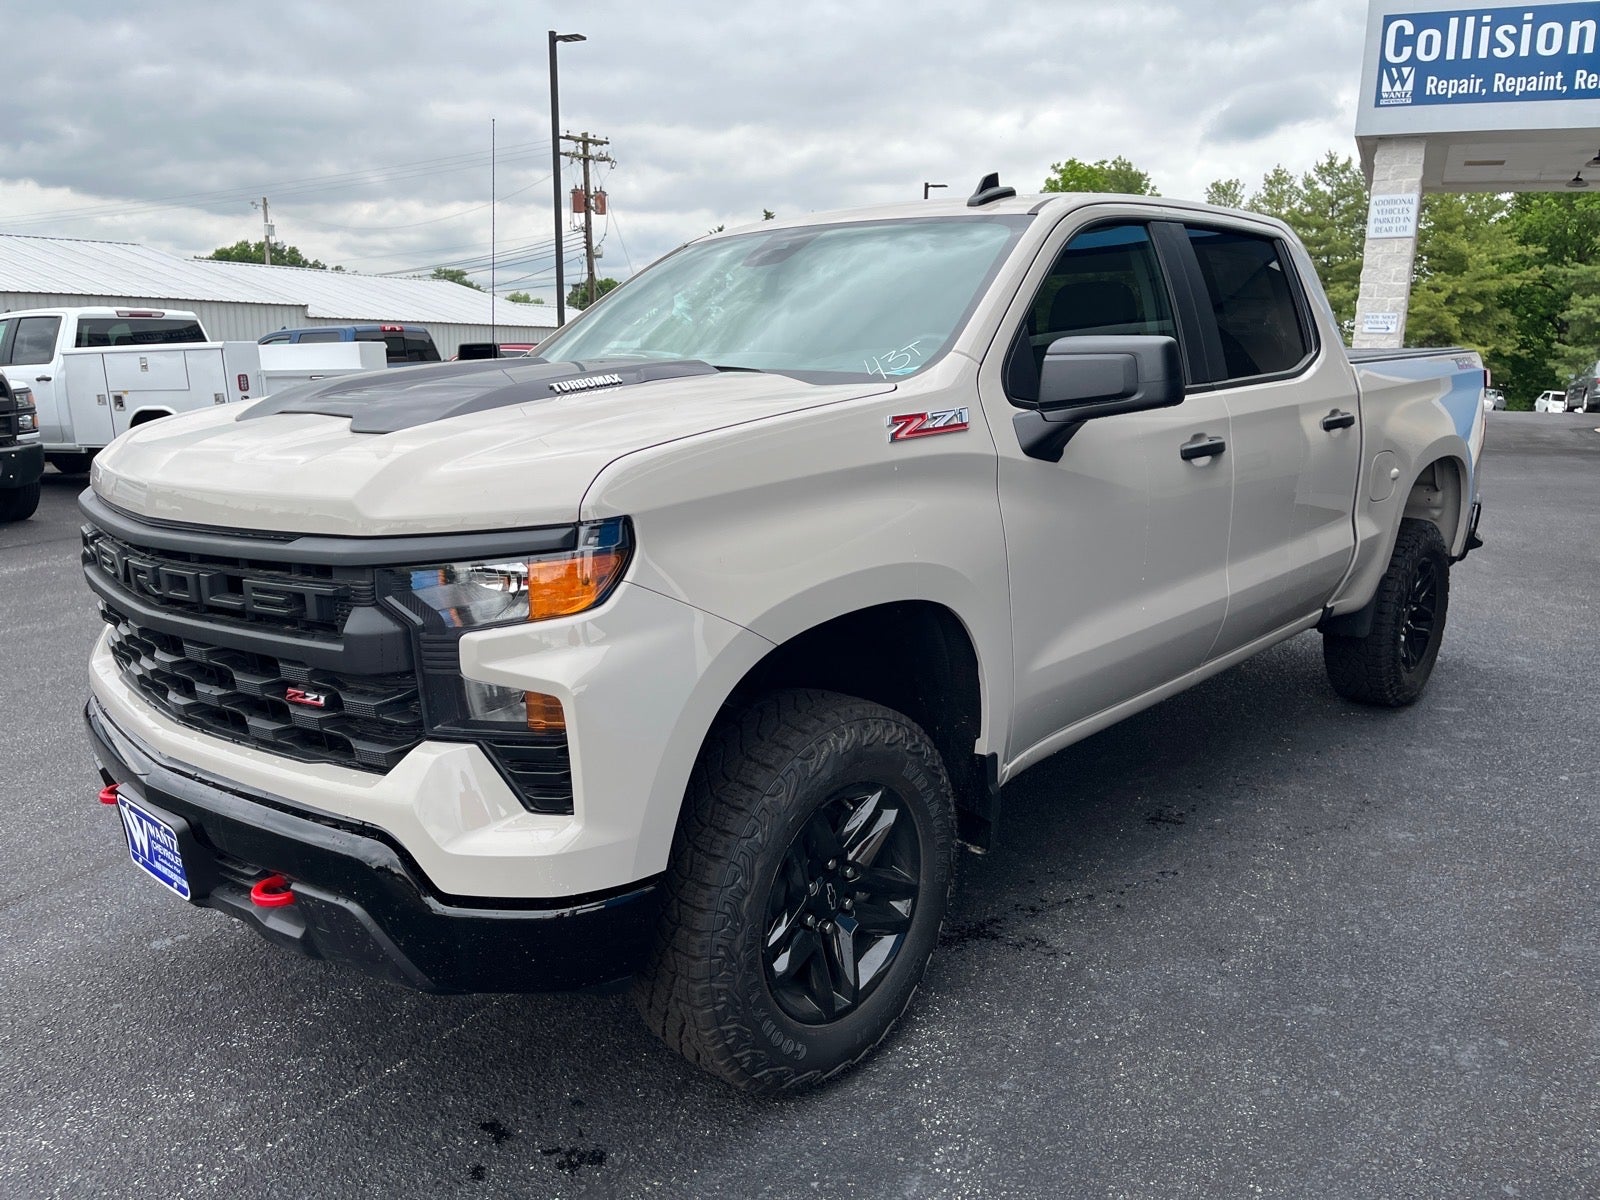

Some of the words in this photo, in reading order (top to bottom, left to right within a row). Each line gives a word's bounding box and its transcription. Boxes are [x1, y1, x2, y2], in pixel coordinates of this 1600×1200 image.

[1384, 12, 1597, 64] Collision
[1425, 74, 1487, 98] Repair,
[1493, 71, 1568, 96] Repaint,
[1574, 69, 1600, 90] Re
[1381, 91, 1413, 99] WANTZ
[1373, 198, 1414, 206] ADDITIONAL
[1376, 207, 1410, 215] VEHICLES
[1374, 216, 1401, 224] PARKED
[1374, 225, 1393, 233] REAR
[1395, 225, 1408, 233] LOT
[549, 373, 624, 394] TURBOMAX
[886, 407, 970, 443] Z71
[285, 687, 326, 707] Z71
[147, 820, 180, 856] WANTZ
